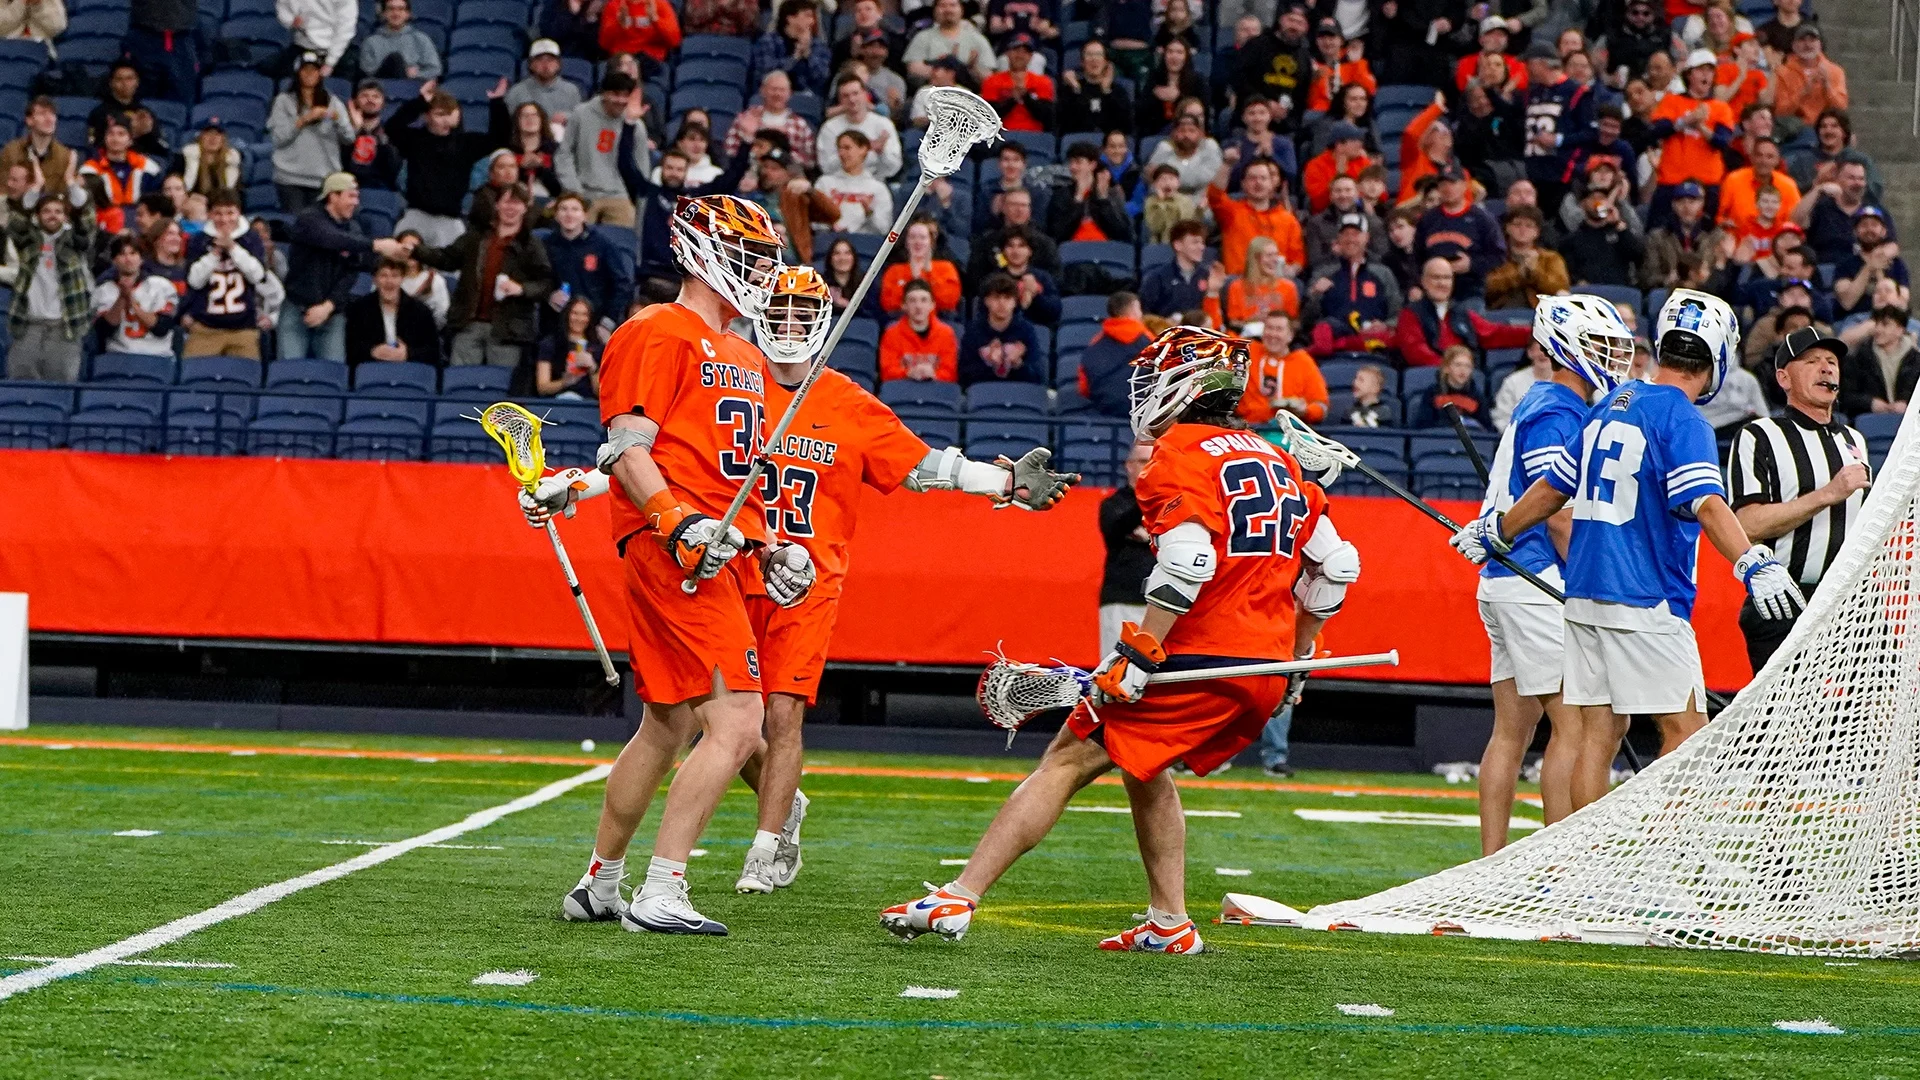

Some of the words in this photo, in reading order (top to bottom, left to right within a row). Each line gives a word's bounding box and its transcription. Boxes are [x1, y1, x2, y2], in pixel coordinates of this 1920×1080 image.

[682, 201, 700, 223] S
[207, 272, 246, 315] 22
[701, 338, 716, 358] C
[1181, 343, 1199, 363] S
[1572, 419, 1647, 526] 13
[1219, 457, 1310, 559] 22
[745, 648, 760, 679] S
[1172, 943, 1183, 953] 22
